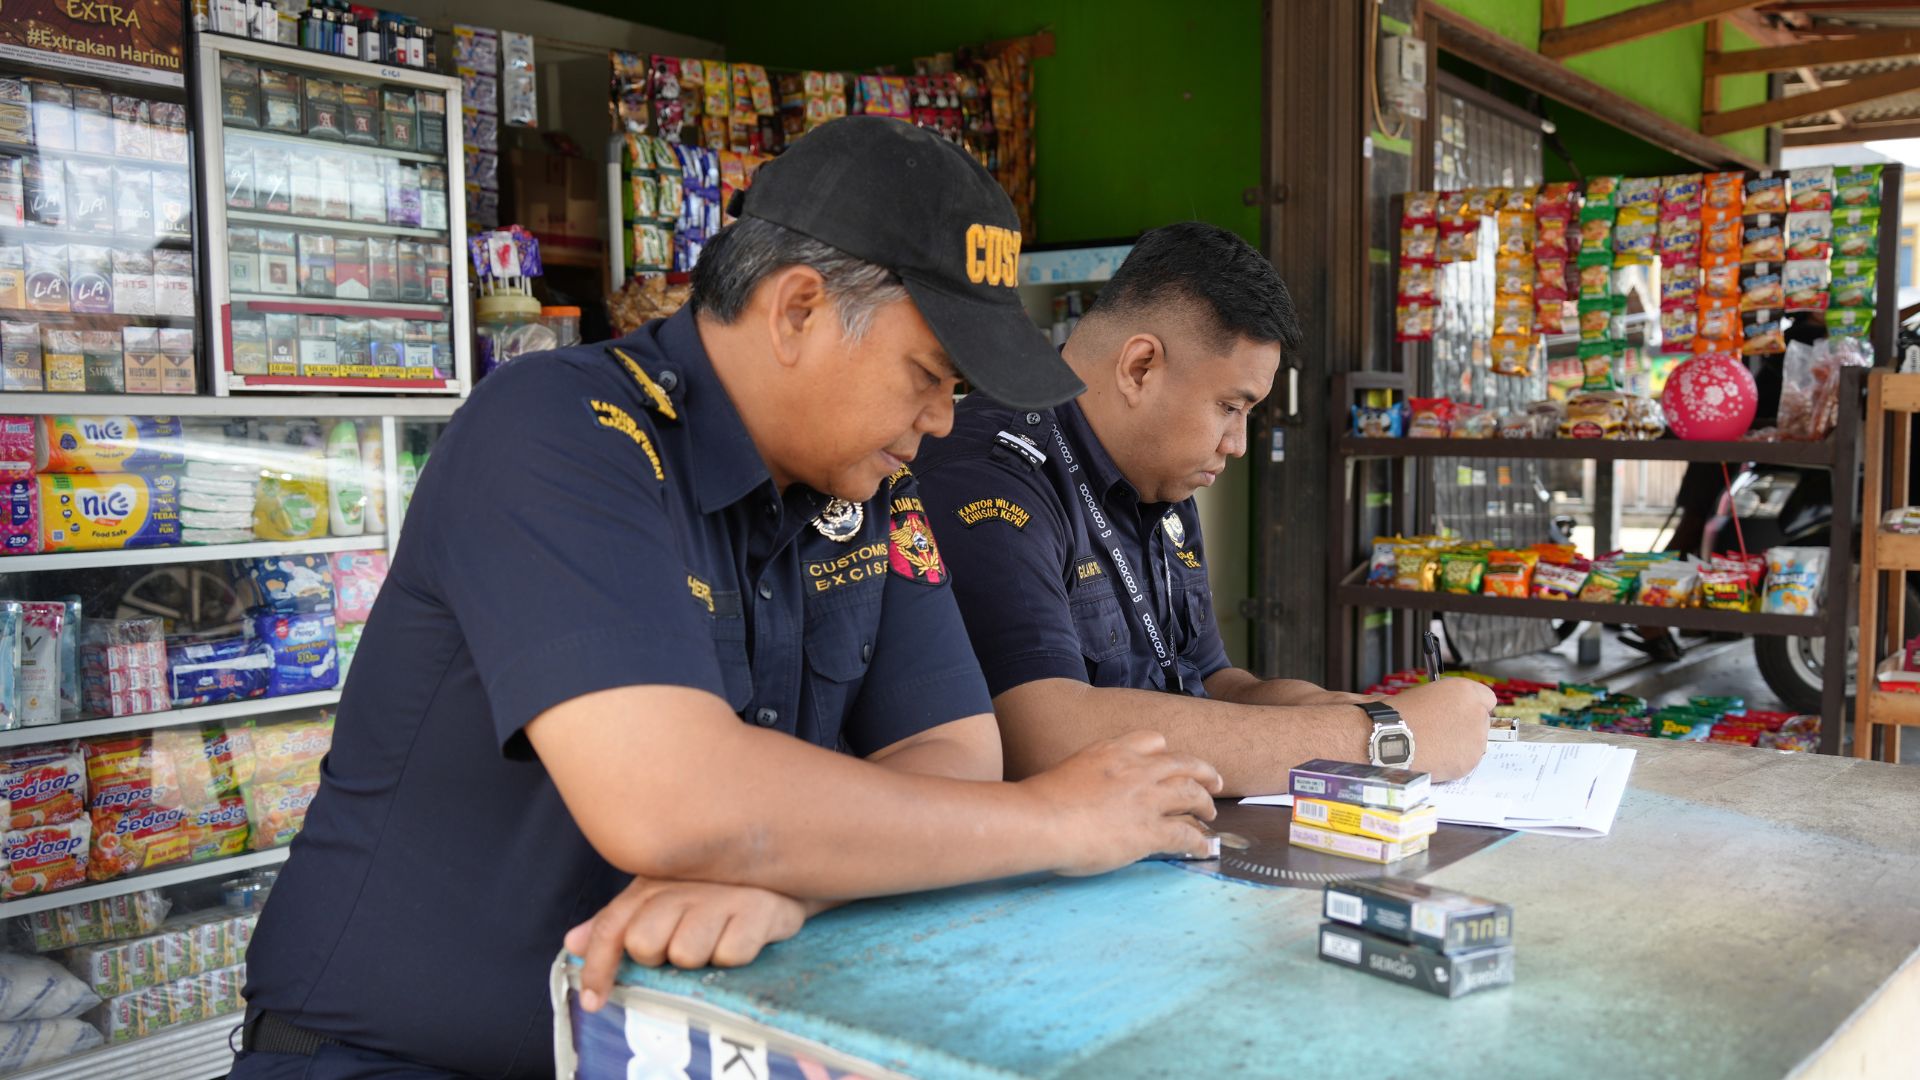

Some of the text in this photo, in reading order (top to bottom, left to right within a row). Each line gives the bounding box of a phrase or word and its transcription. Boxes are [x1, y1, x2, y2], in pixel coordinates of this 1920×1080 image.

[66, 0, 141, 30] EXTRA
[27, 28, 116, 57] #Extrakan
[121, 44, 179, 69] Harimu
[5, 368, 41, 379] RAPTOR
[958, 498, 1031, 521] KANTOR WILAYAH
[964, 508, 1027, 528] KHUSUS KEPRI
[92, 529, 128, 538] Food Safe
[809, 543, 888, 577] CUSTOMS
[1453, 916, 1510, 945] BULL
[1368, 953, 1417, 980] SERGIO
